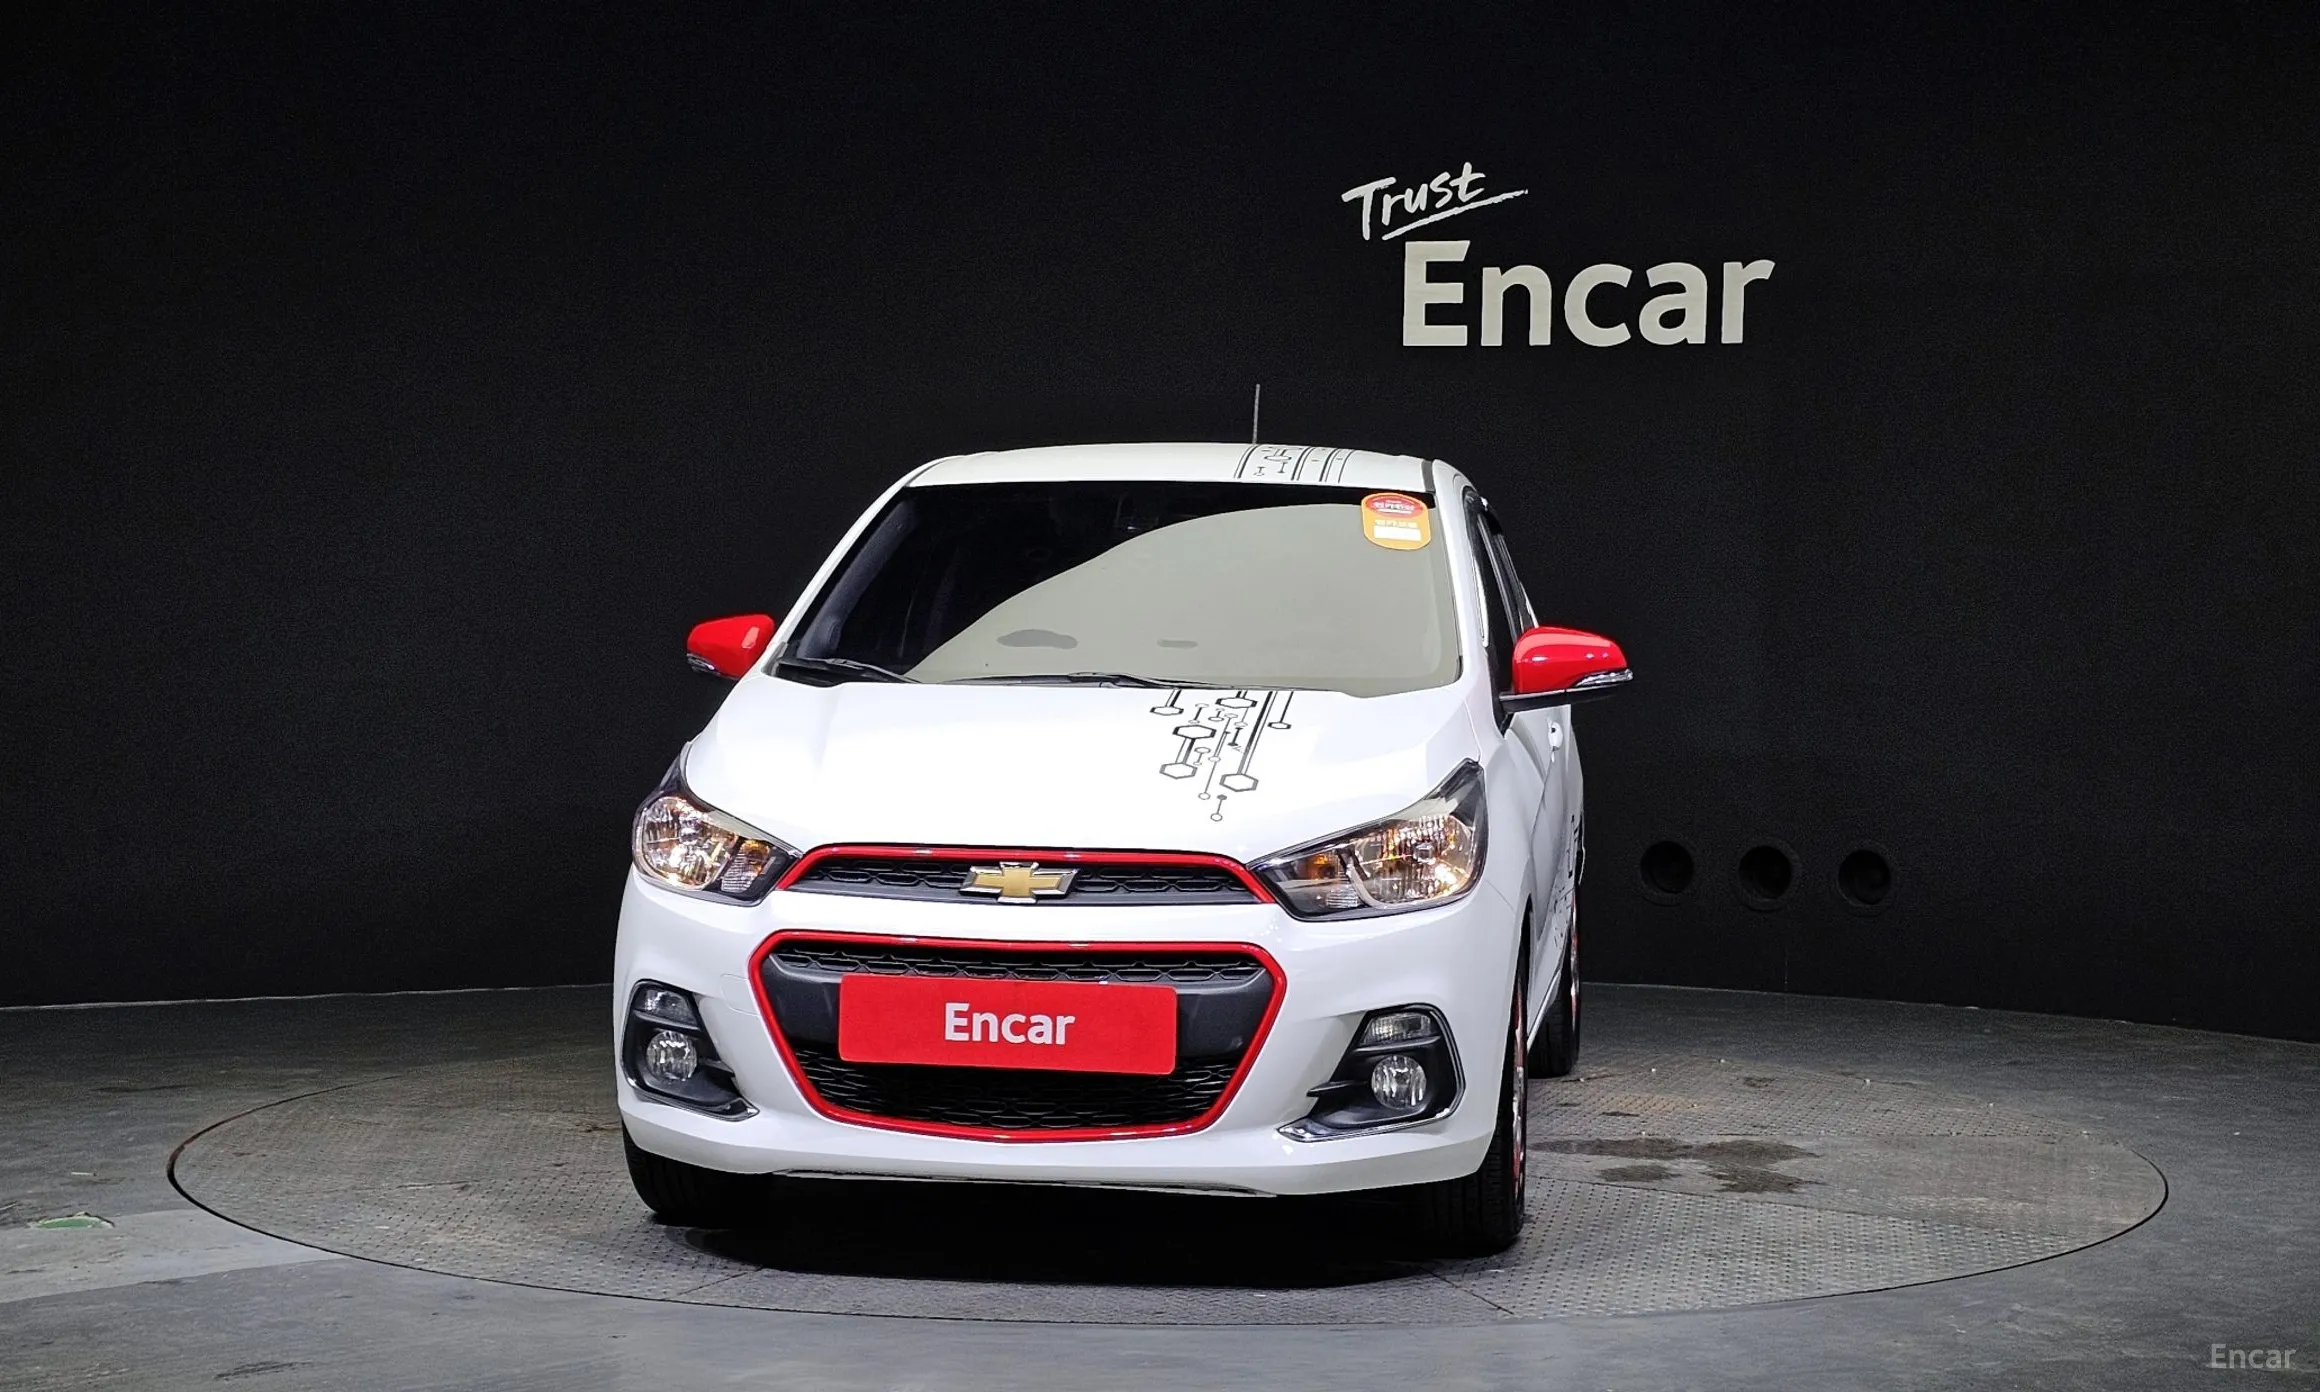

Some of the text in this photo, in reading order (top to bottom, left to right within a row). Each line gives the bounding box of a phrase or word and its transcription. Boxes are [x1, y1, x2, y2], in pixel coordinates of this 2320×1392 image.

[1341, 161, 1486, 241] Trust
[1402, 240, 1776, 347] Encar
[944, 1002, 1077, 1045] Encar
